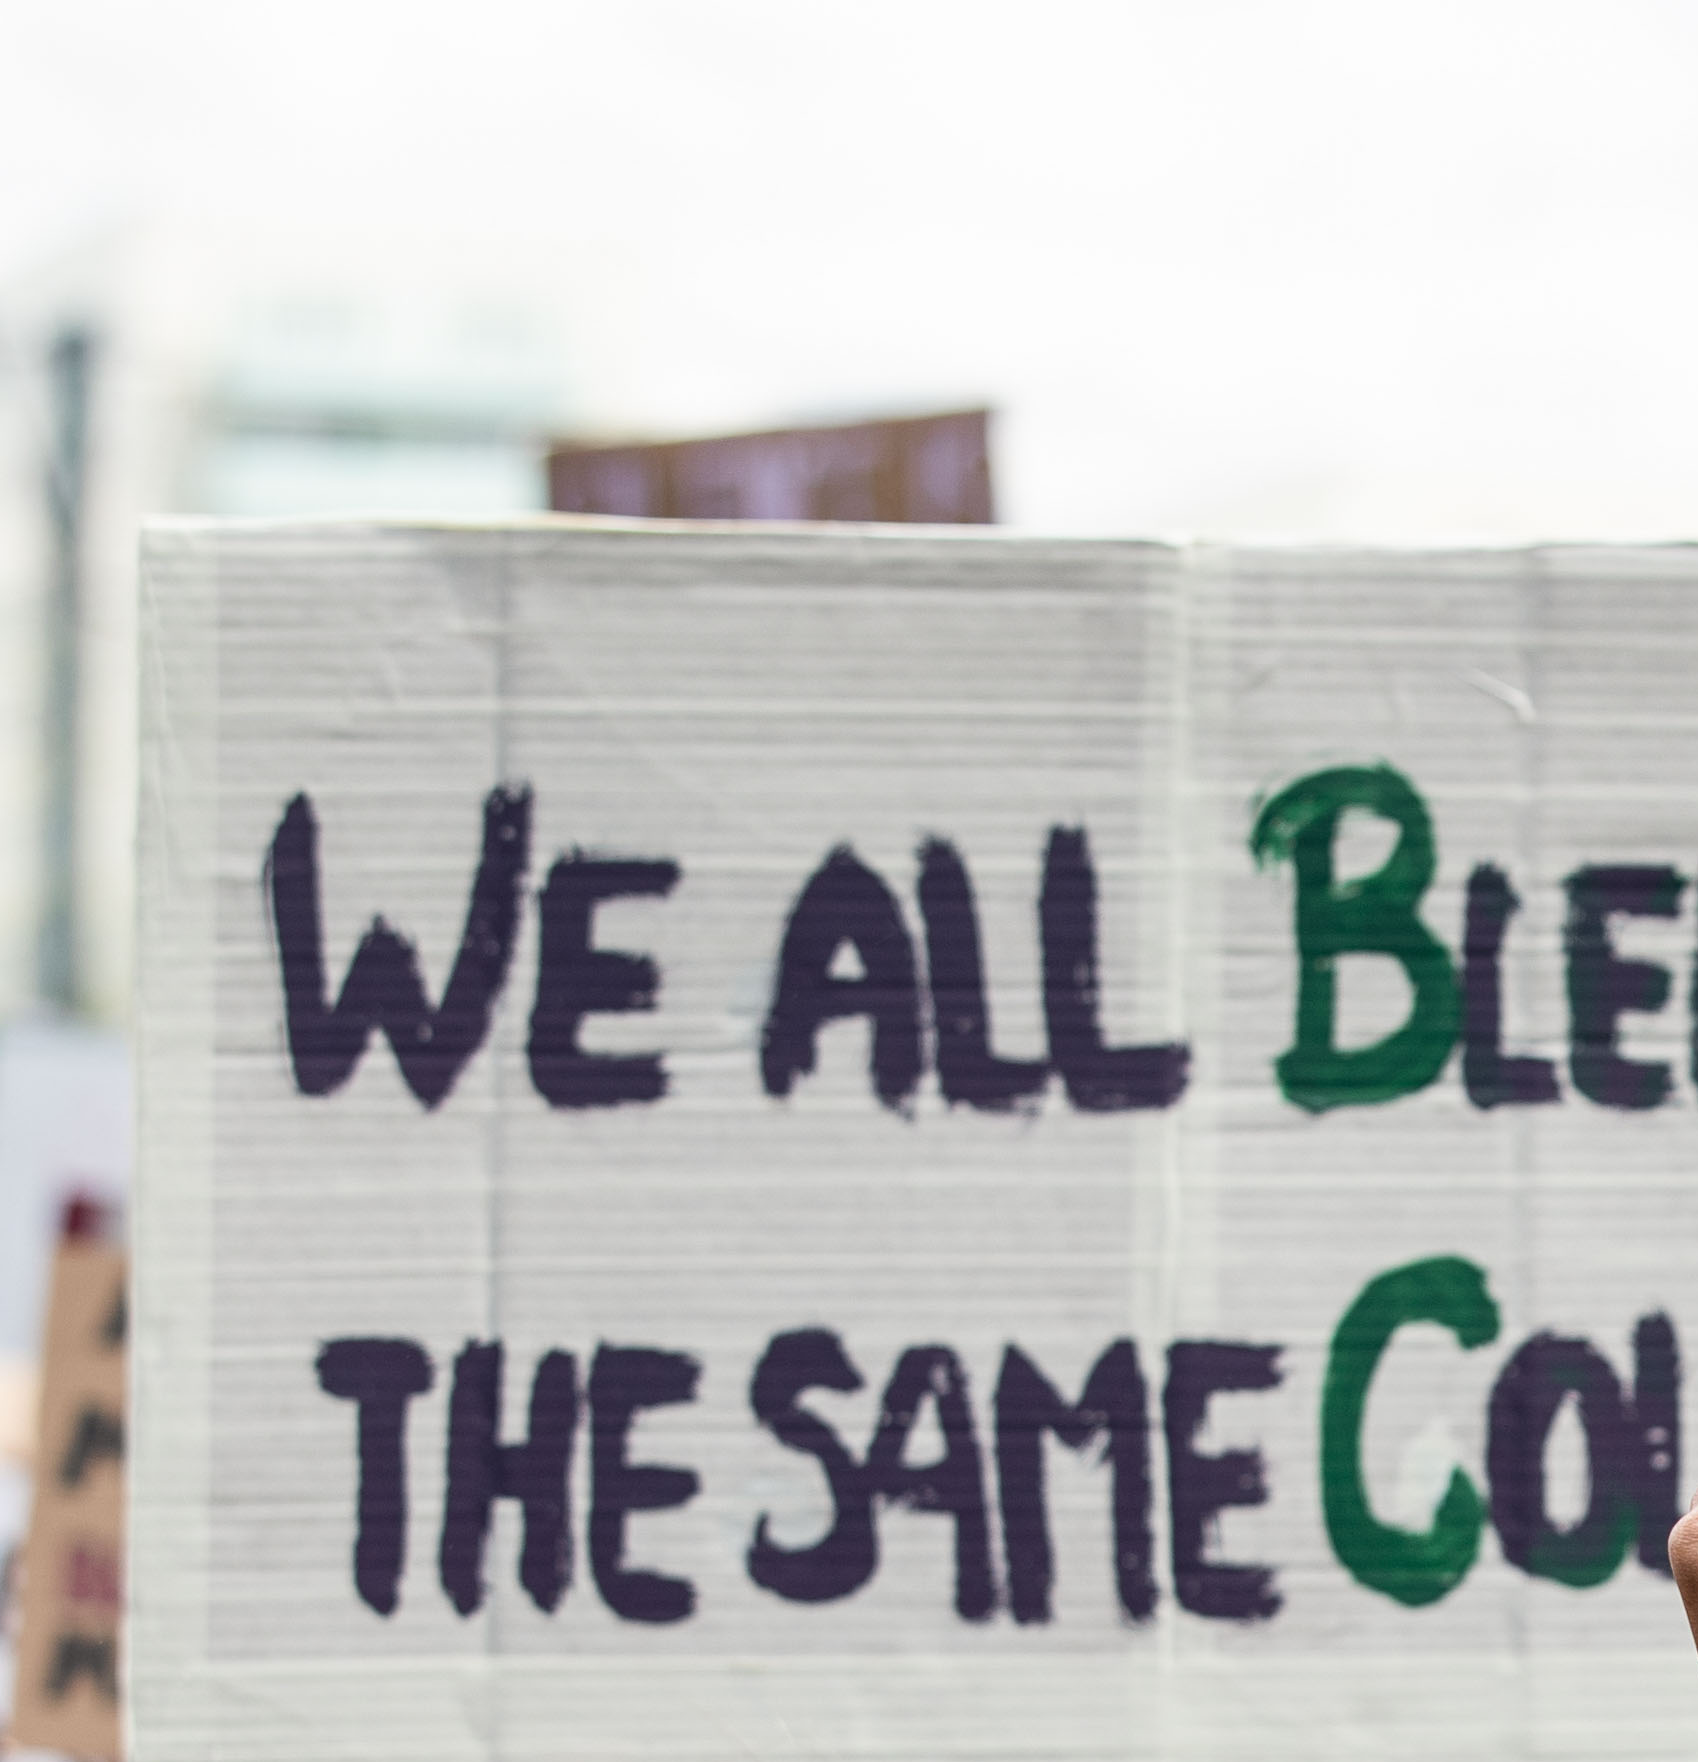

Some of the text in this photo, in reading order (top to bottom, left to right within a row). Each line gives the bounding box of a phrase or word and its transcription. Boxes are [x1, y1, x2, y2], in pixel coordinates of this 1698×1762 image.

[262, 782, 683, 1112] WE
[758, 823, 1192, 1121] ALL
[314, 1337, 703, 1624] THE
[745, 1327, 1291, 1626] SAME
